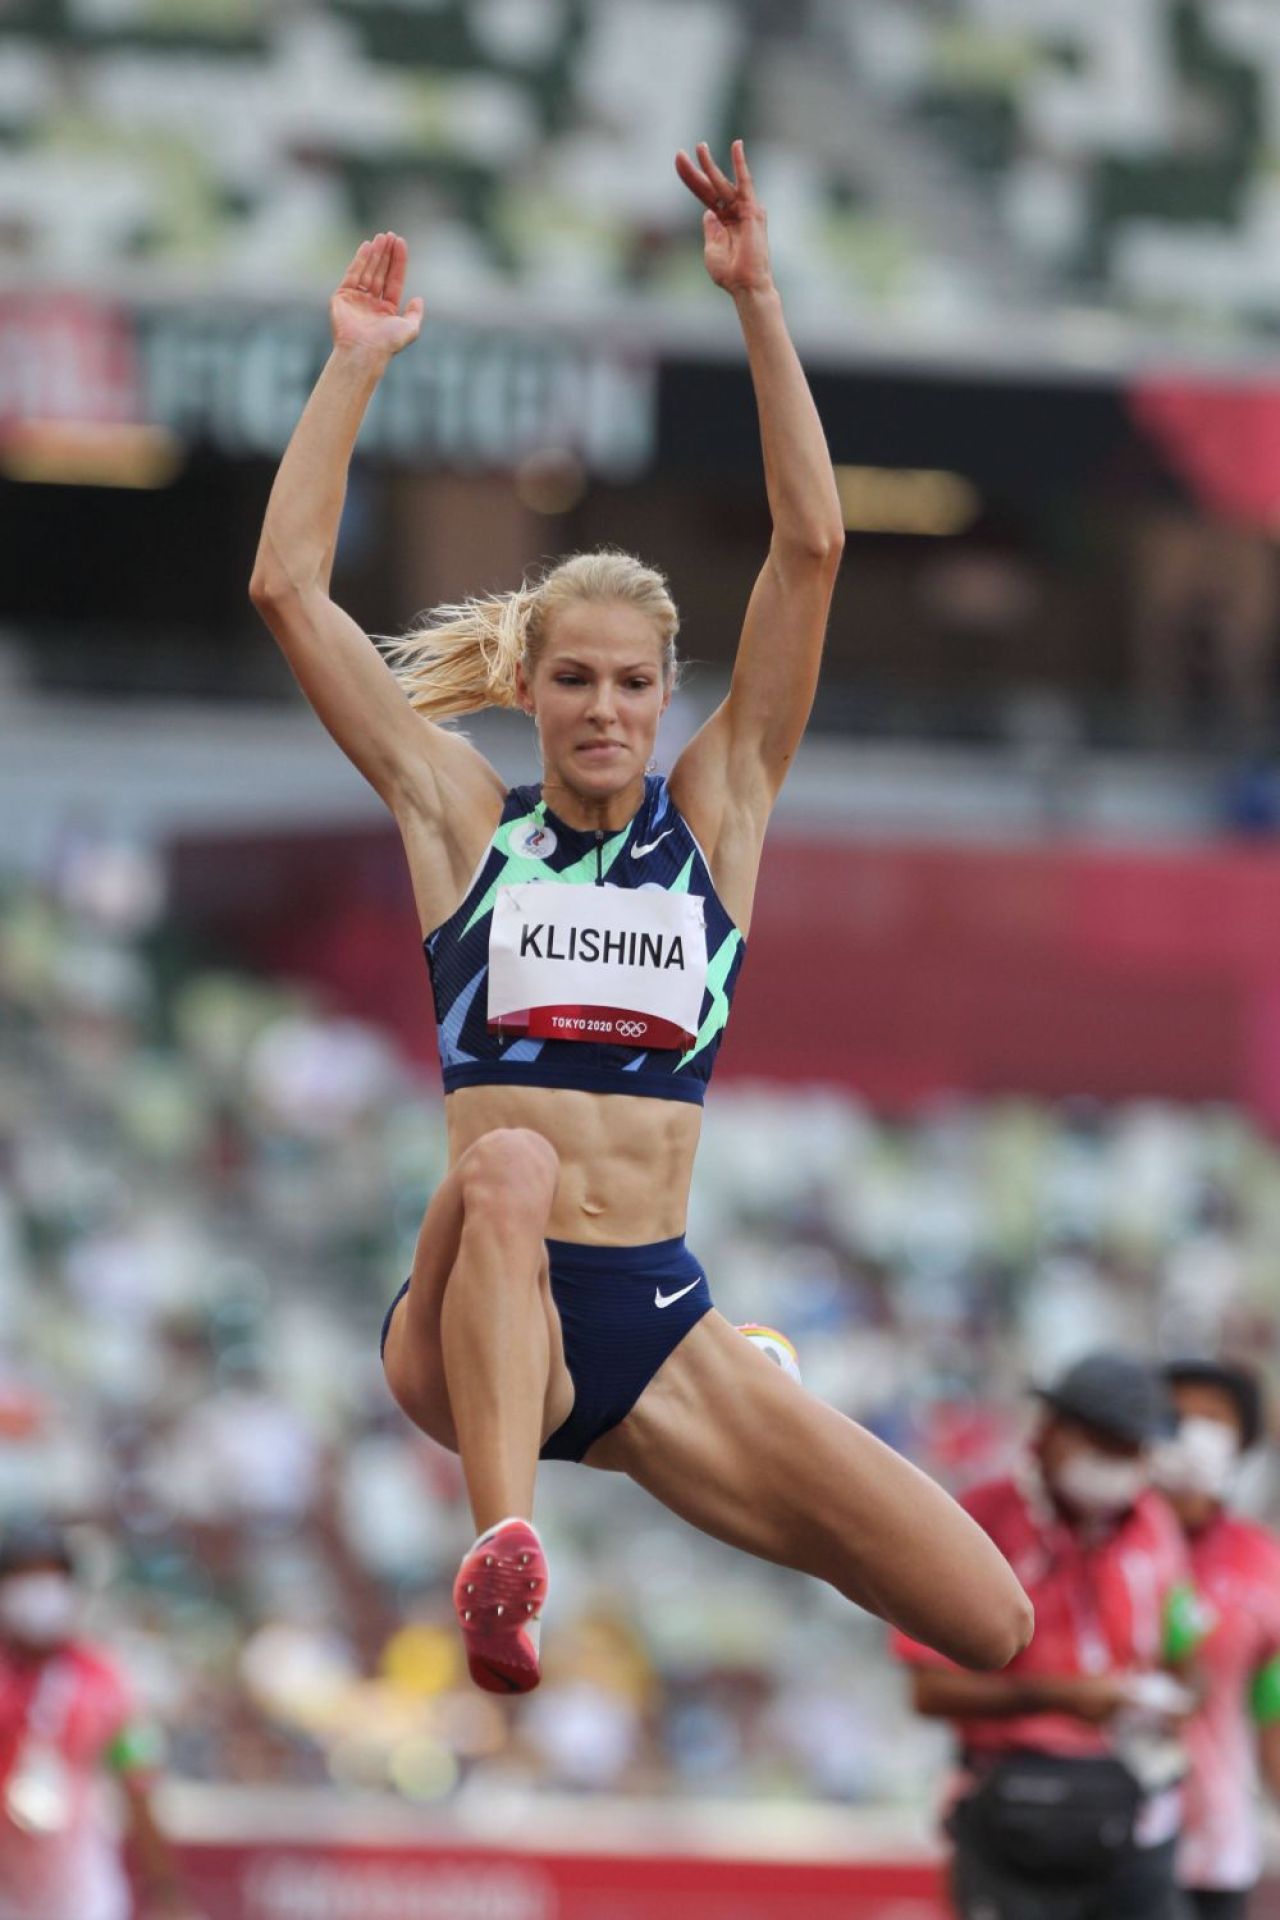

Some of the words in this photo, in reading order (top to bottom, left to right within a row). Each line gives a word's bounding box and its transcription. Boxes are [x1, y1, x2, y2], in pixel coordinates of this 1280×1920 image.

[520, 923, 685, 970] KLISHINA
[551, 1017, 586, 1030] TOKYO
[587, 1020, 613, 1032] 2020
